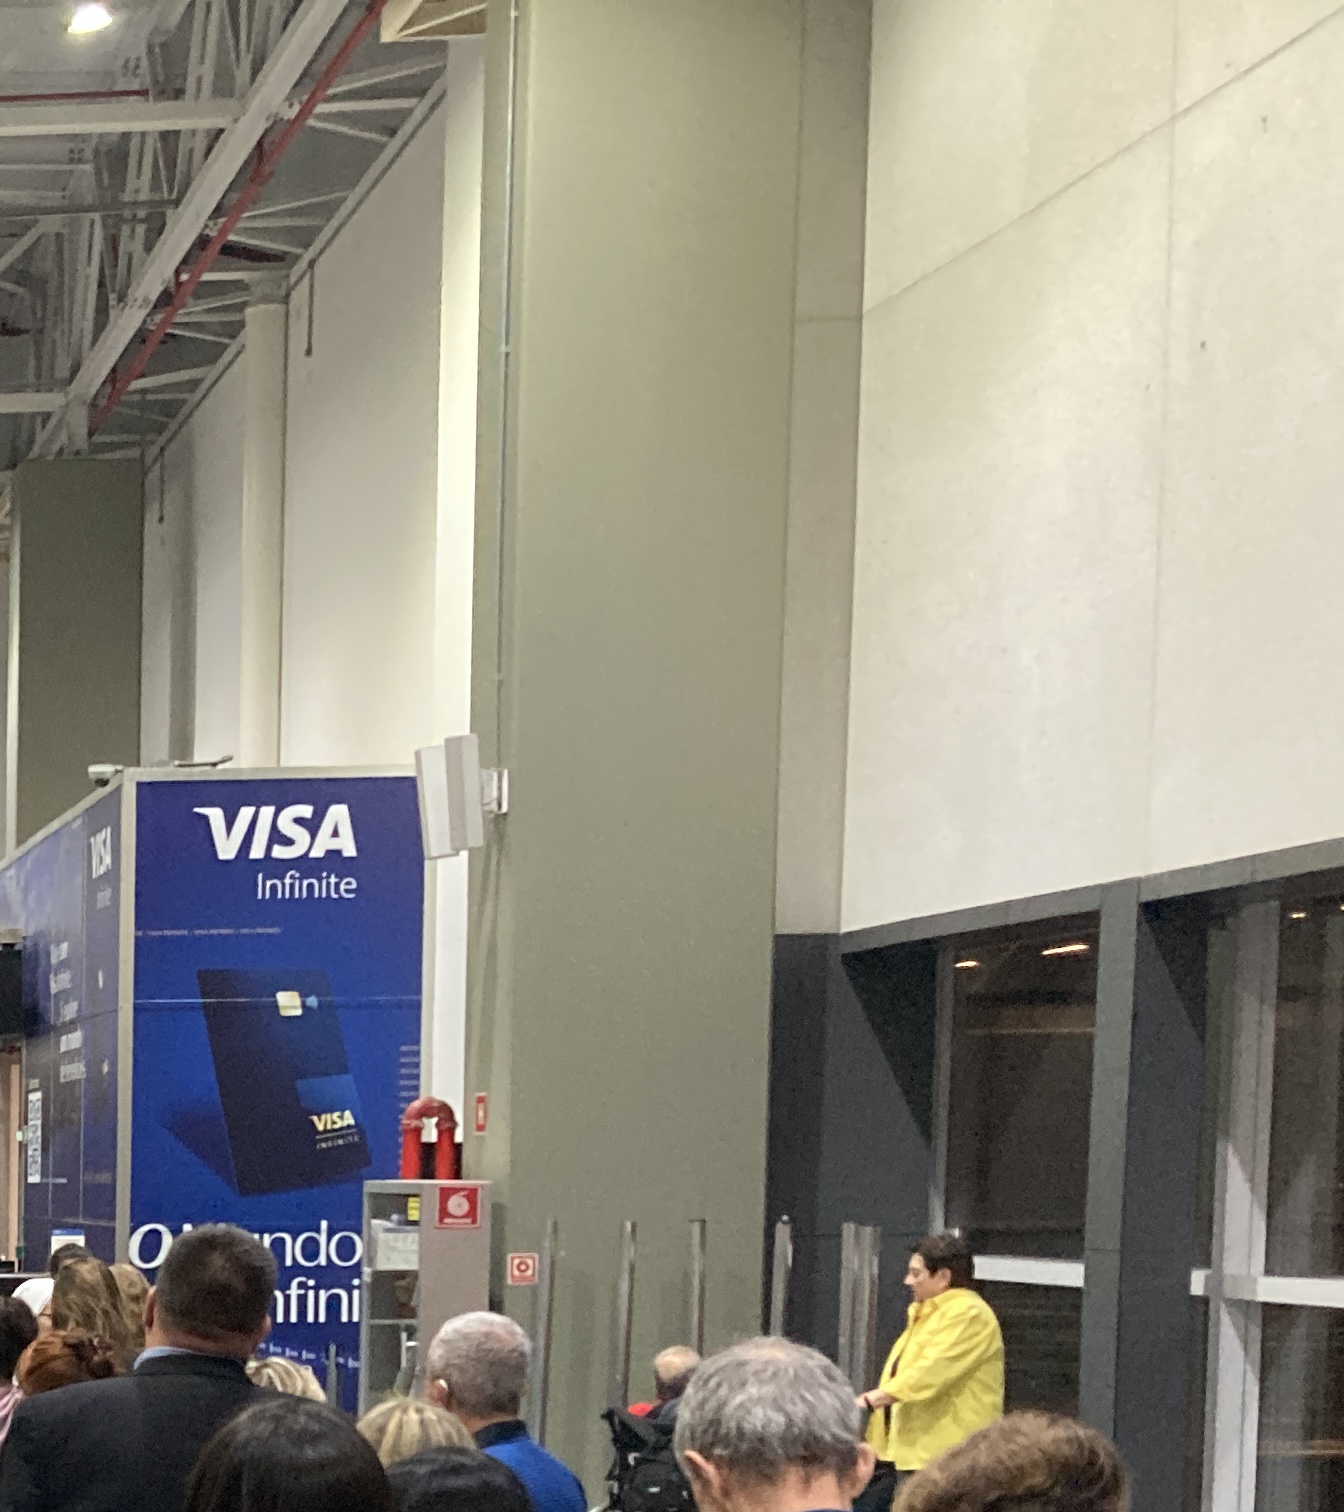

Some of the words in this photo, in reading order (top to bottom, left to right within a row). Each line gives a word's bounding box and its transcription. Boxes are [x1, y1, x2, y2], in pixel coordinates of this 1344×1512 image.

[89, 825, 112, 880] VISA
[193, 804, 358, 860] VISA
[256, 869, 358, 900] Infinite
[309, 1109, 356, 1132] VISA
[182, 1219, 363, 1268] ndo
[273, 1276, 361, 1323] nfini
